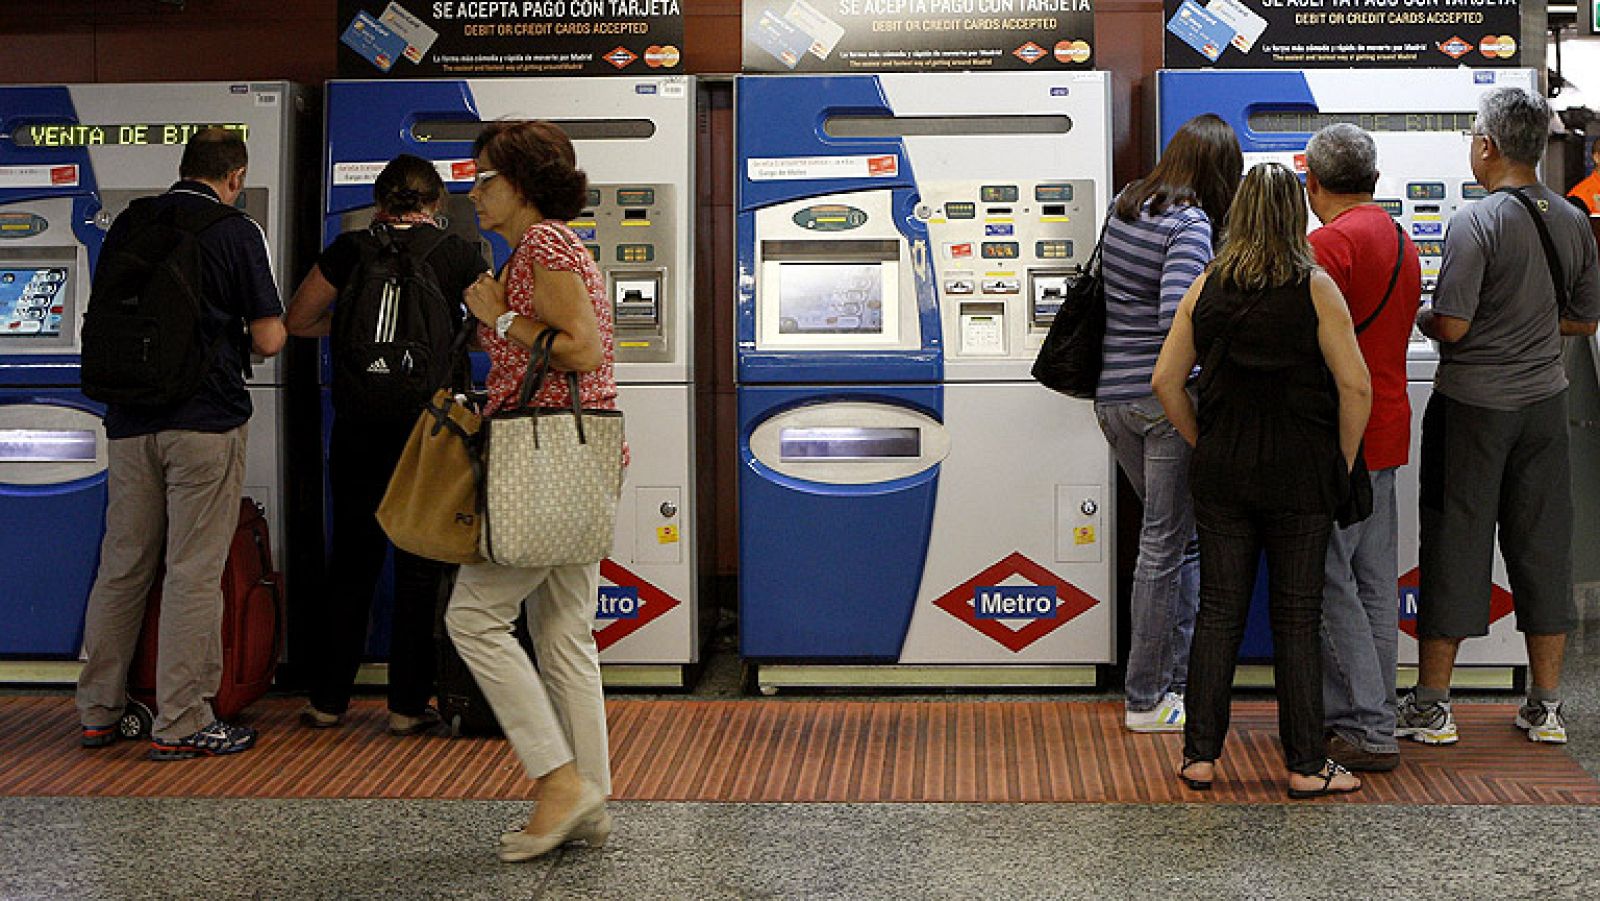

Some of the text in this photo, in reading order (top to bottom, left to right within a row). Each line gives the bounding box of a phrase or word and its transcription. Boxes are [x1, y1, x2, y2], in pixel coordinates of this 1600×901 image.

[432, 0, 681, 19] SE ACEPTA PAGO CON TARJETA
[839, 0, 860, 15] SE
[863, 0, 927, 14] ACEPTA
[964, 18, 1001, 30] CARDS
[1001, 17, 1058, 30] ACCEPTED
[1295, 12, 1484, 25] DEBIT OR CREDIT CARDS ACCEPTED
[463, 22, 650, 36] DEBIT OR CREDIT CARDS ACCEPTED
[30, 126, 105, 146] VENTA
[119, 126, 149, 145] DE
[600, 593, 634, 614] tro
[981, 592, 1051, 614] Metro
